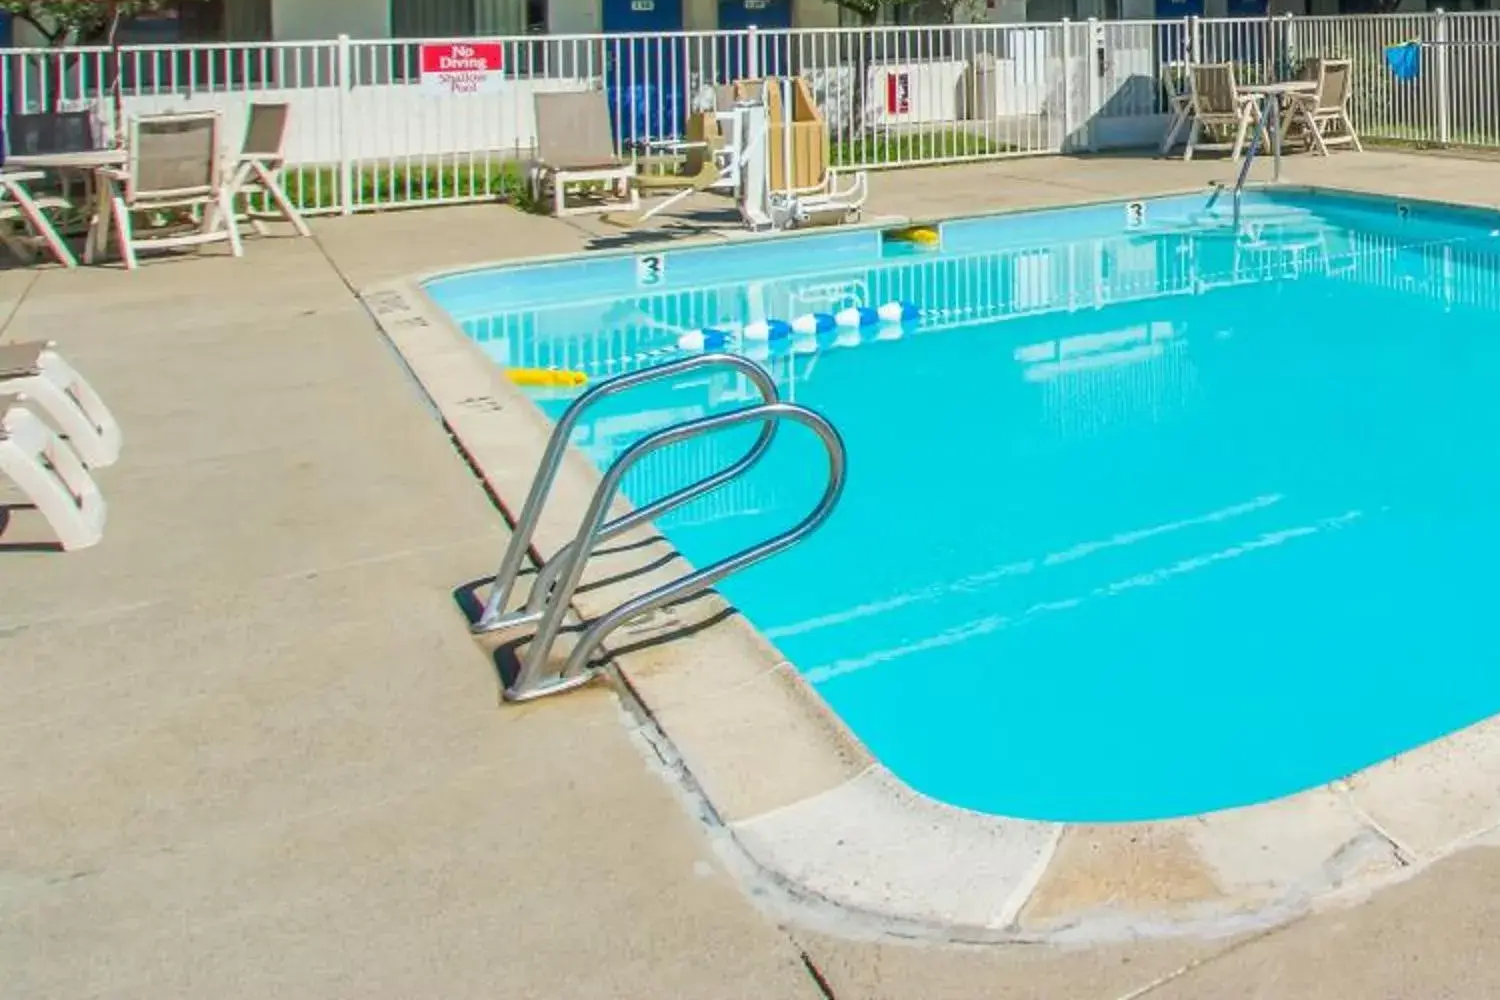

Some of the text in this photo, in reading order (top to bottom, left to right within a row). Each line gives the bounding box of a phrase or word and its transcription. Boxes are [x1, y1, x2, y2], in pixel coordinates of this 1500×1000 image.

[451, 46, 475, 58] No
[440, 56, 488, 70] Diving
[642, 256, 660, 285] 3
